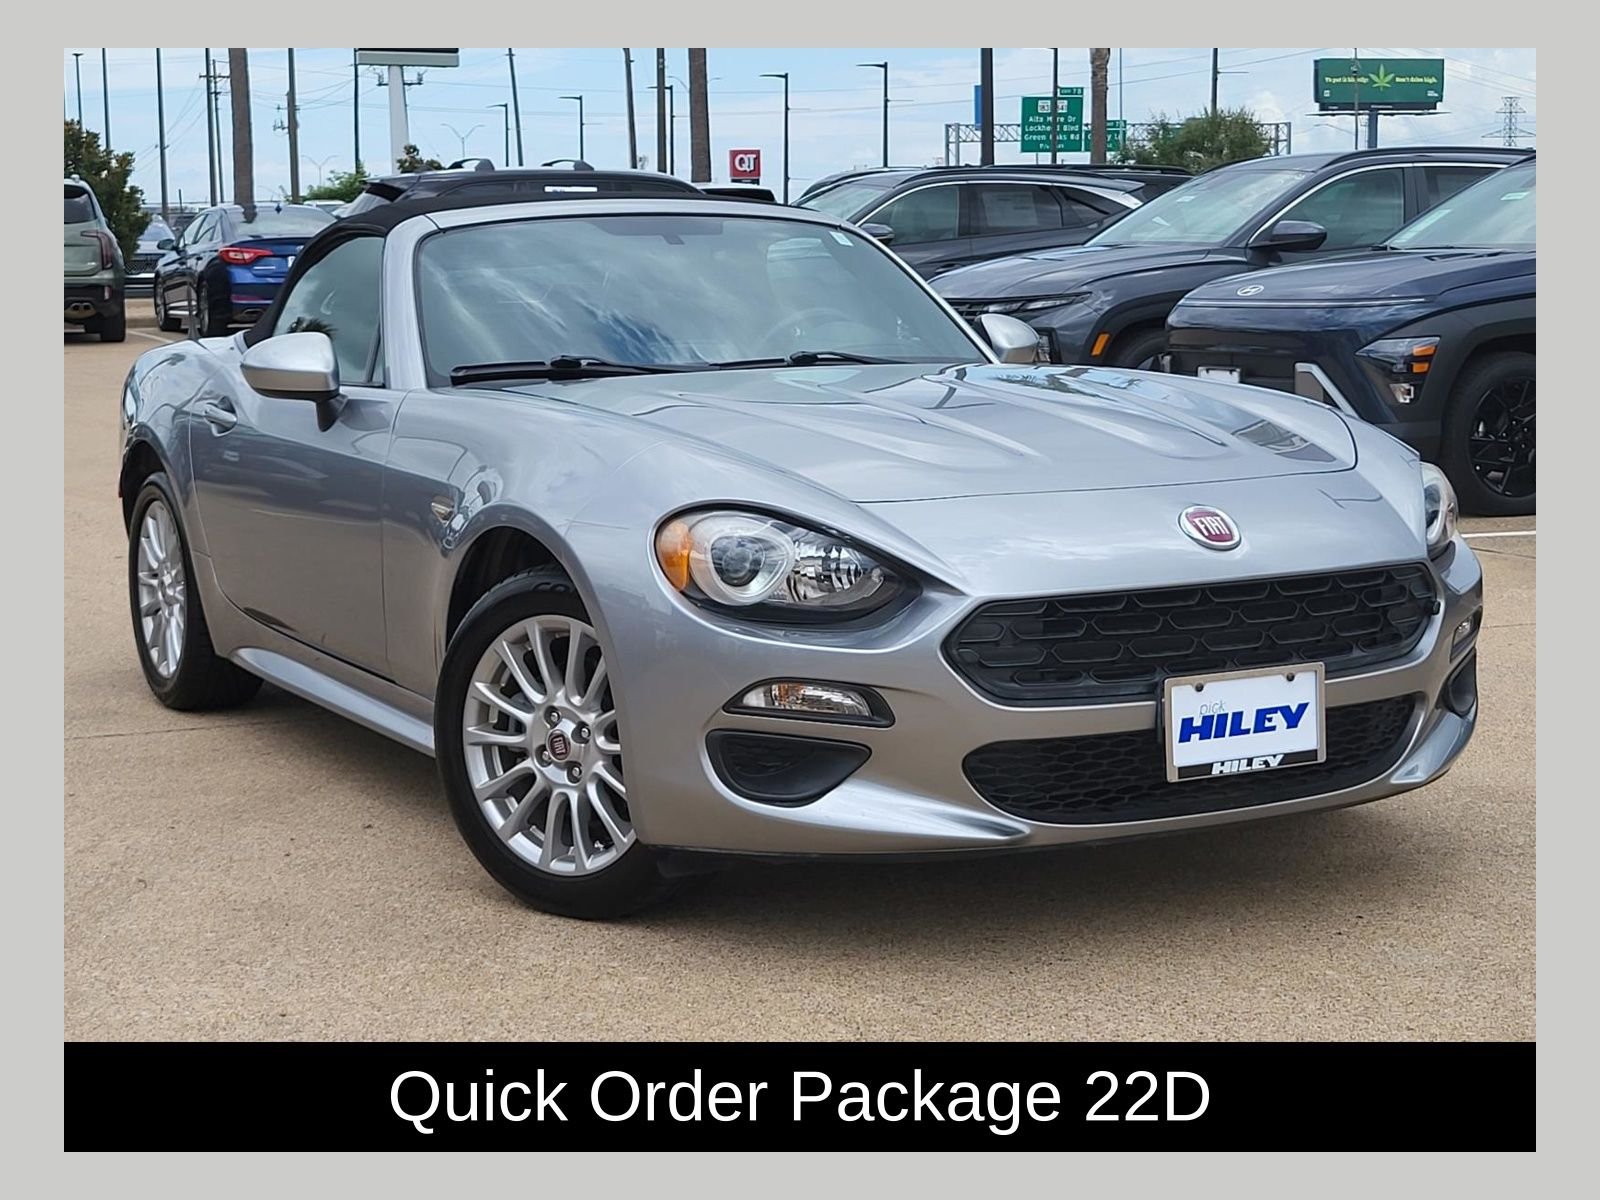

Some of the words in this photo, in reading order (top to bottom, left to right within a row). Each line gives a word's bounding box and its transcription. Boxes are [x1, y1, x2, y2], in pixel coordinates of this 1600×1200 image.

[1024, 124, 1060, 132] Lockhed
[1063, 124, 1080, 132] Blvd
[1067, 115, 1077, 123] Dr
[1070, 133, 1080, 141] Rd
[734, 153, 757, 172] QT
[1192, 516, 1231, 537] FIAT
[1199, 699, 1227, 718] pick
[1178, 701, 1311, 744] HILEY
[1211, 753, 1286, 776] HILEY
